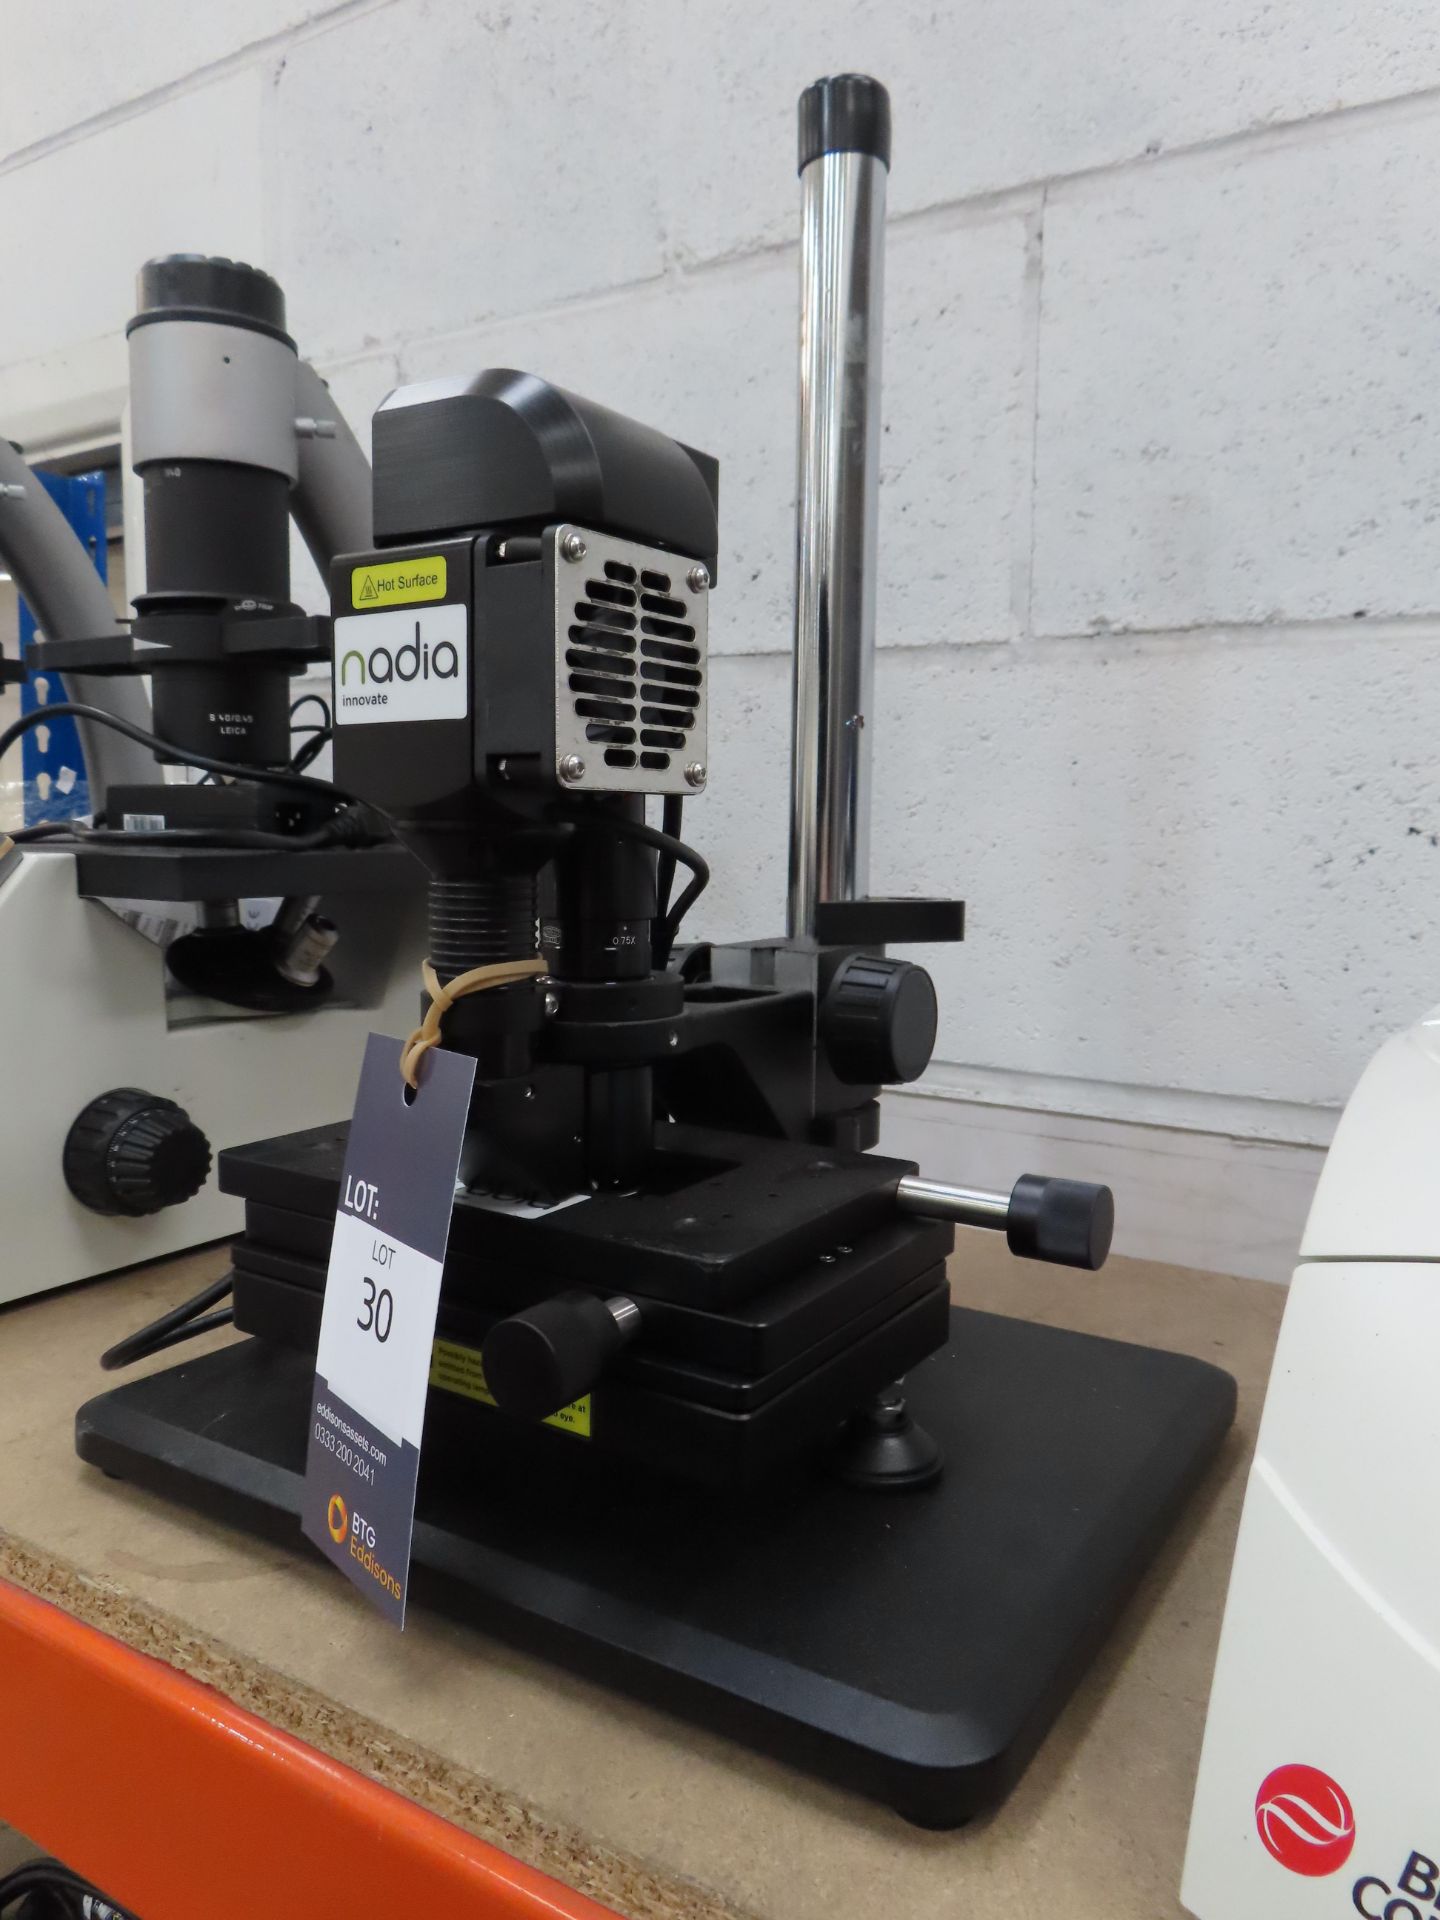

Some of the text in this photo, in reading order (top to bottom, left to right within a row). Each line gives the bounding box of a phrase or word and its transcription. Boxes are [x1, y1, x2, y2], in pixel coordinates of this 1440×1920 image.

[377, 573, 438, 592] Hot Surface
[341, 621, 459, 686] nadia
[342, 693, 388, 707] innovate
[220, 726, 246, 735] LEICA
[344, 1174, 379, 1220] LOT:
[372, 1240, 396, 1270] LOT
[357, 1276, 393, 1343] 30
[315, 1422, 376, 1486] 0333 200 2041
[316, 1402, 387, 1467] eddisonsassets.com
[352, 1511, 376, 1549] BTG
[350, 1535, 402, 1600] Eddisons
